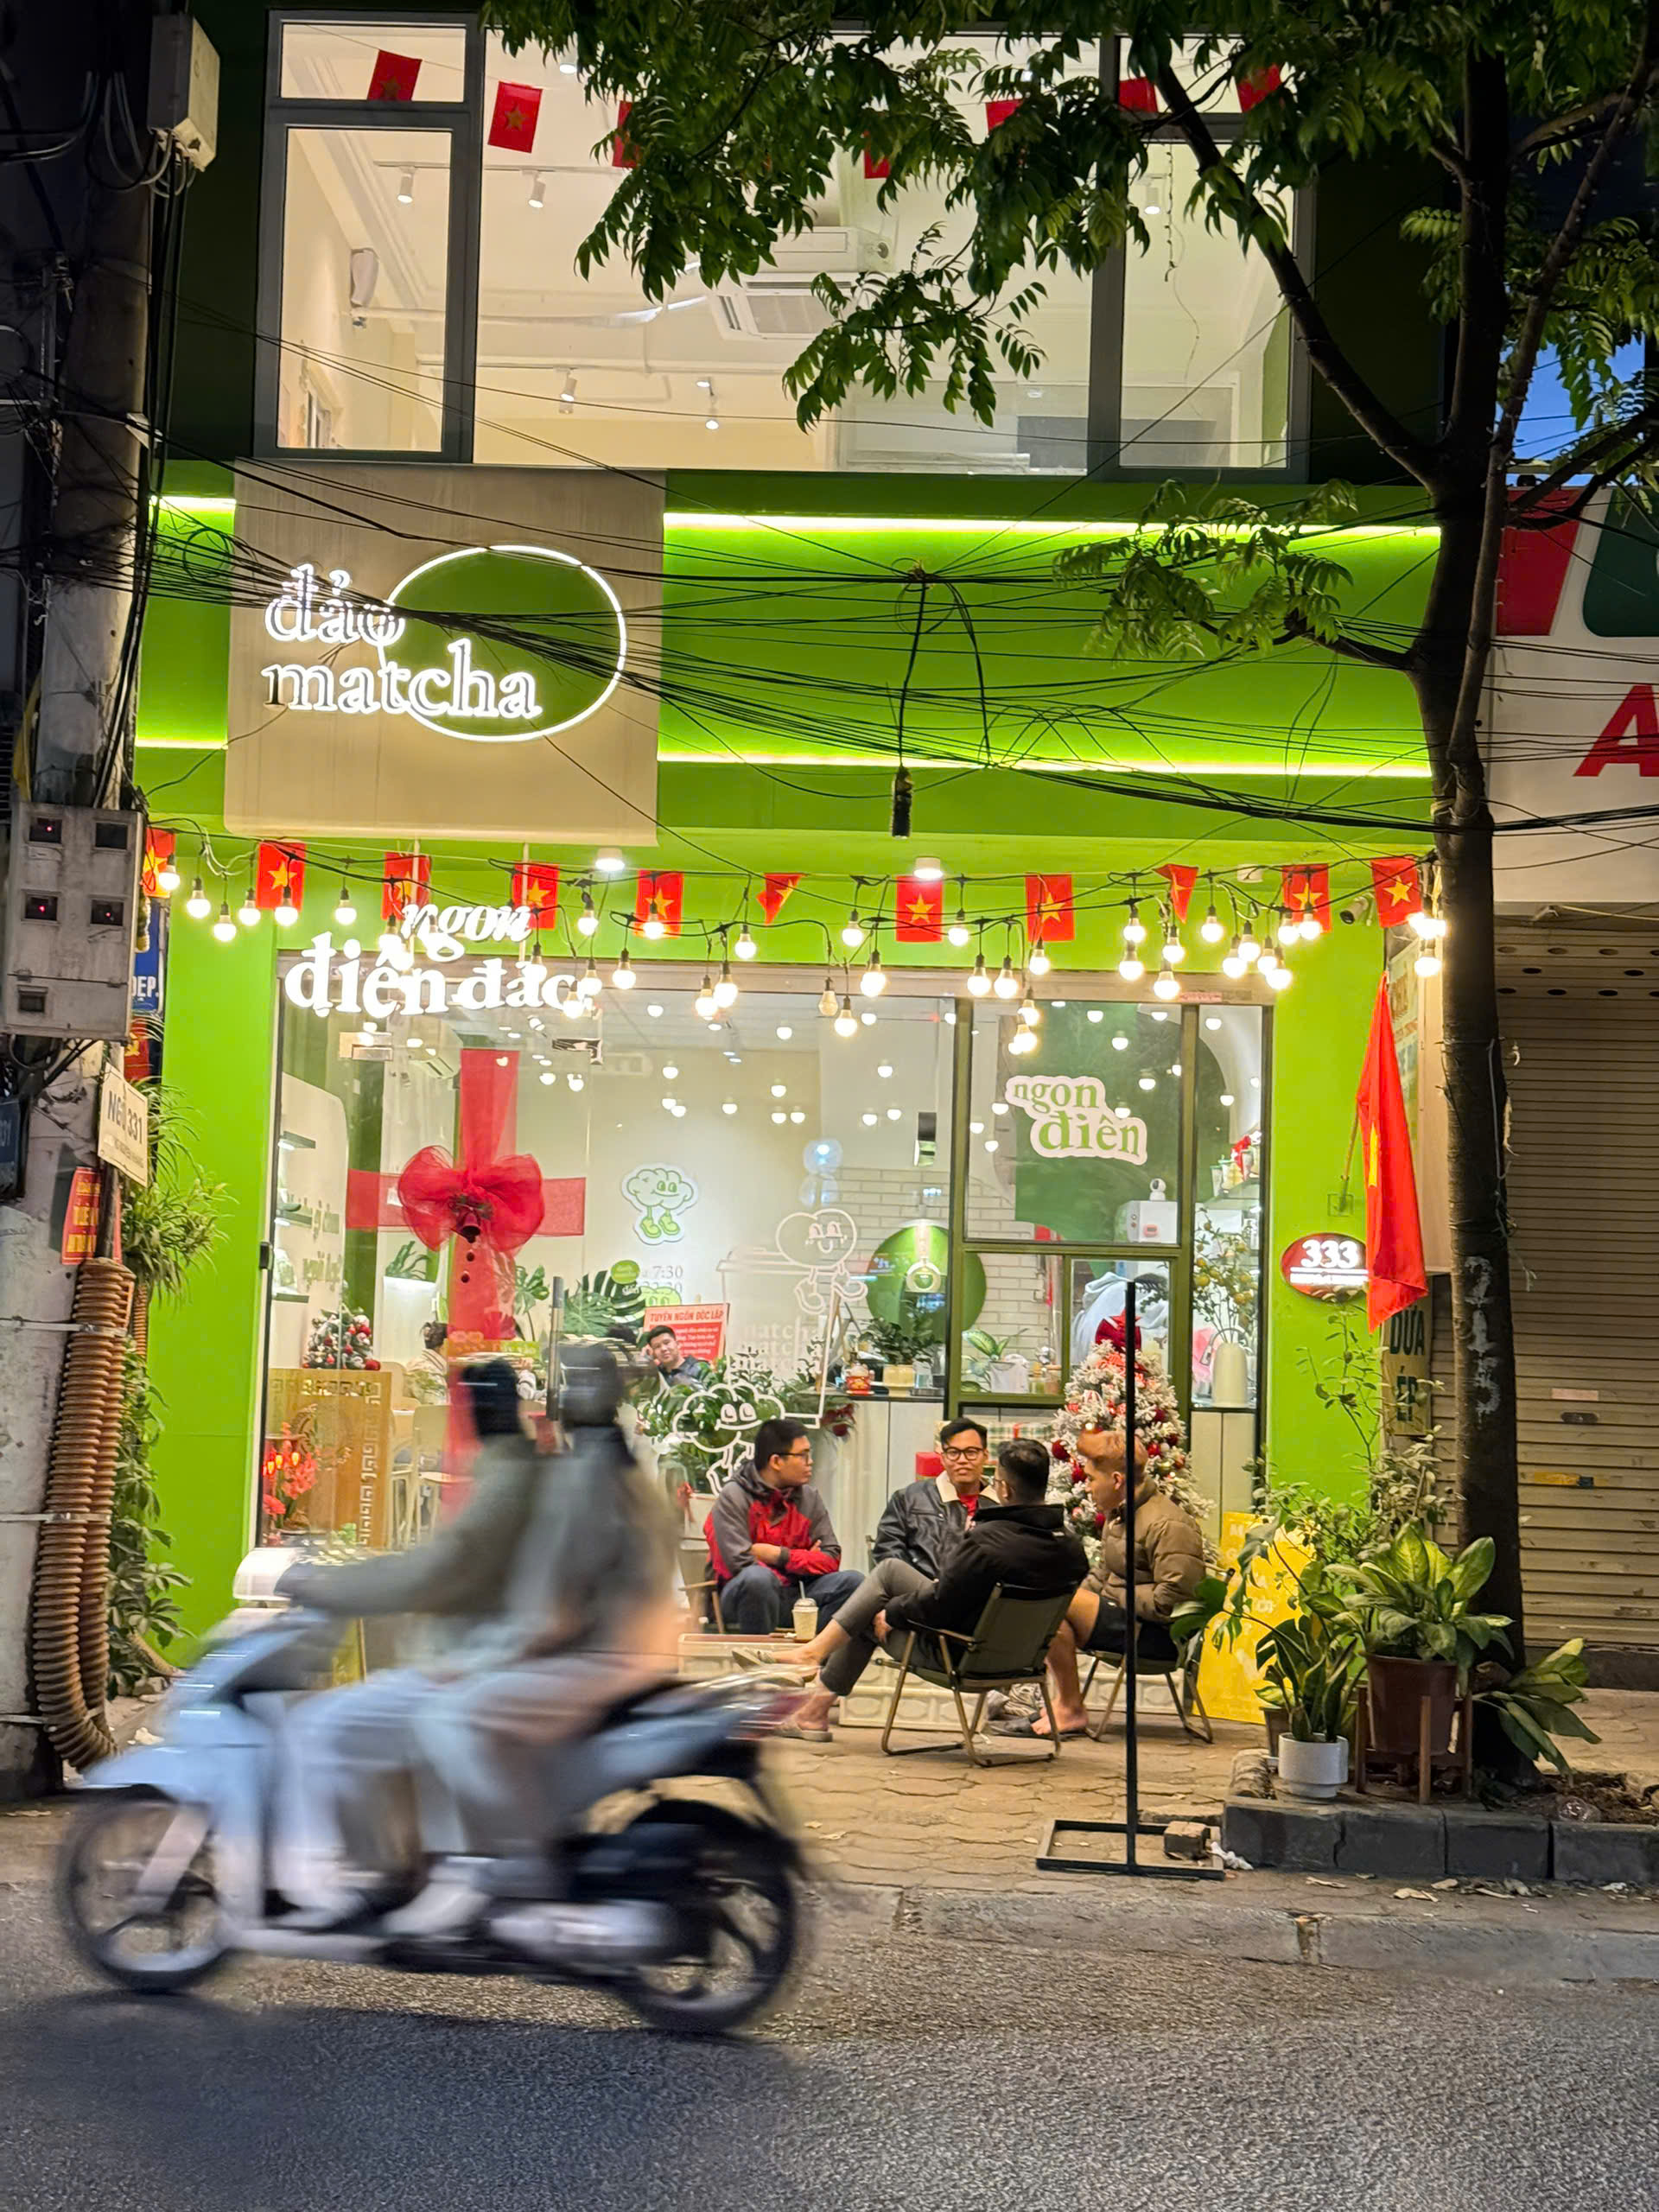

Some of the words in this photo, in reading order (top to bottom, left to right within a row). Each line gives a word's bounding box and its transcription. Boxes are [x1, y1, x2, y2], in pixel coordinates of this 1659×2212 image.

[261, 638, 543, 719] matcha
[401, 904, 532, 963] ngon
[284, 931, 450, 1019] điên
[1014, 1083, 1100, 1114] ngon
[1039, 1110, 1141, 1158] điên
[652, 1265, 683, 1279] 7:30
[1300, 1238, 1359, 1268] 333
